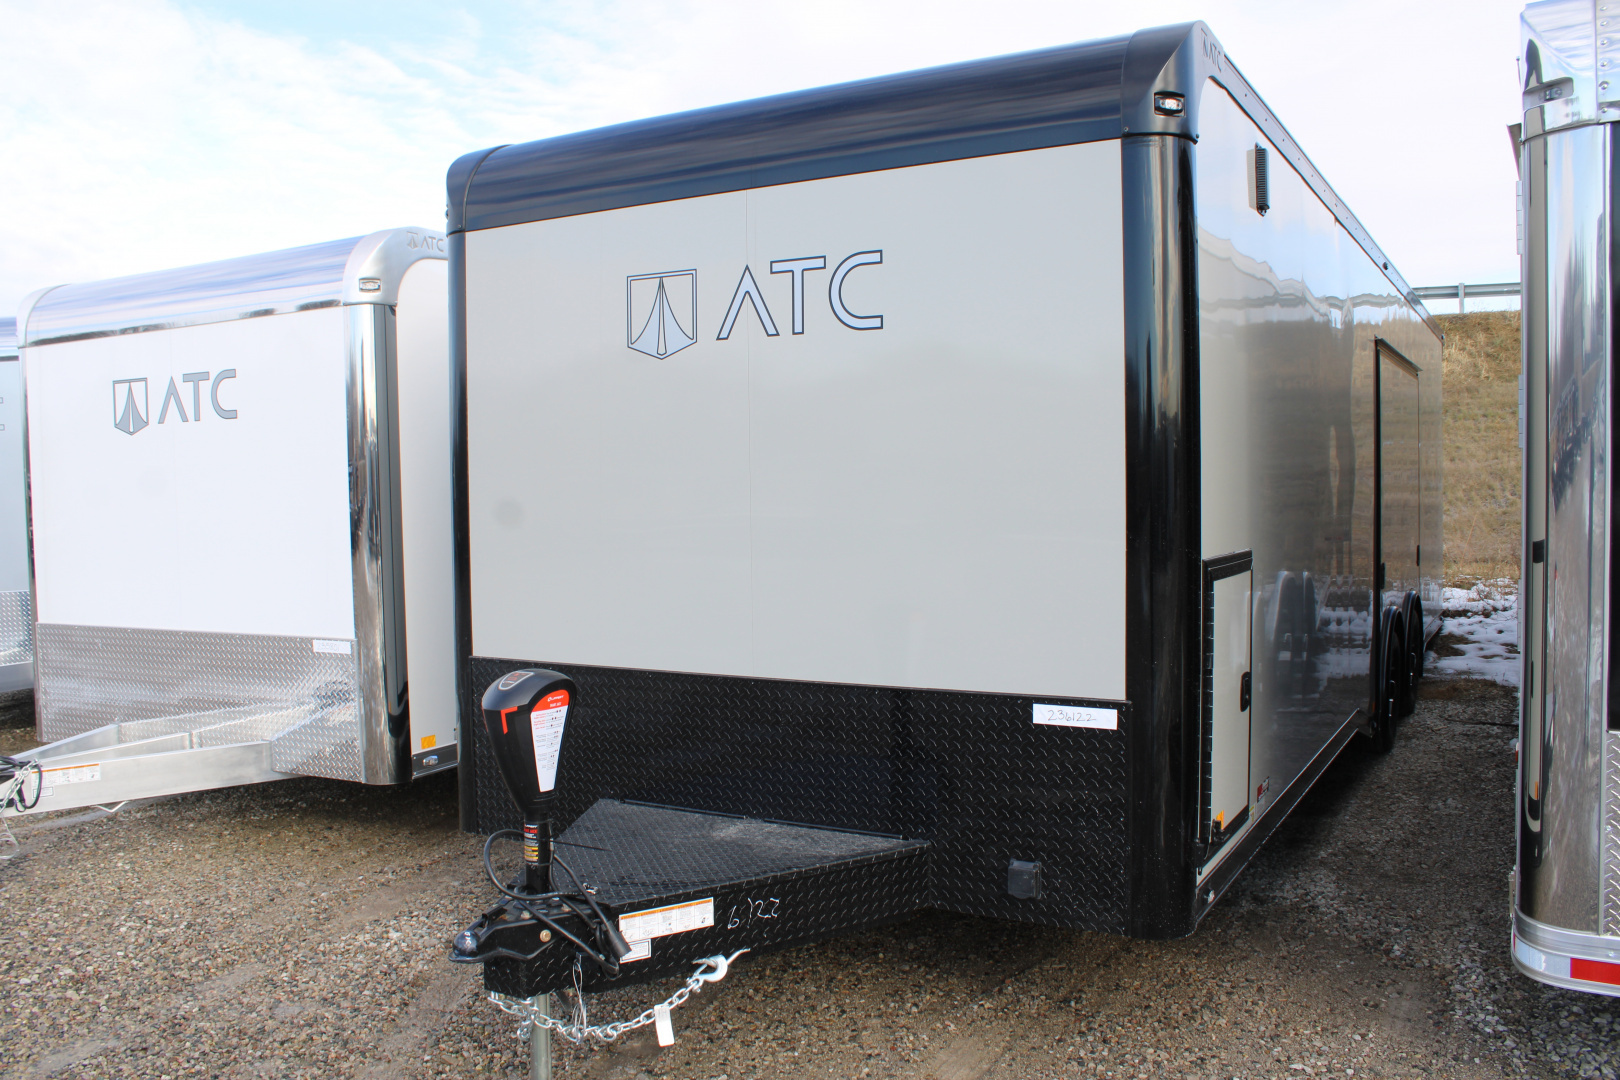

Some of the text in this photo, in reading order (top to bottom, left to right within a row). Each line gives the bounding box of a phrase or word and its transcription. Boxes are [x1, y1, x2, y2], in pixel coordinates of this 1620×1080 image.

[420, 235, 445, 253] ATC
[716, 249, 884, 341] ATC
[157, 368, 238, 424] ATC
[1047, 709, 1097, 722] 236122
